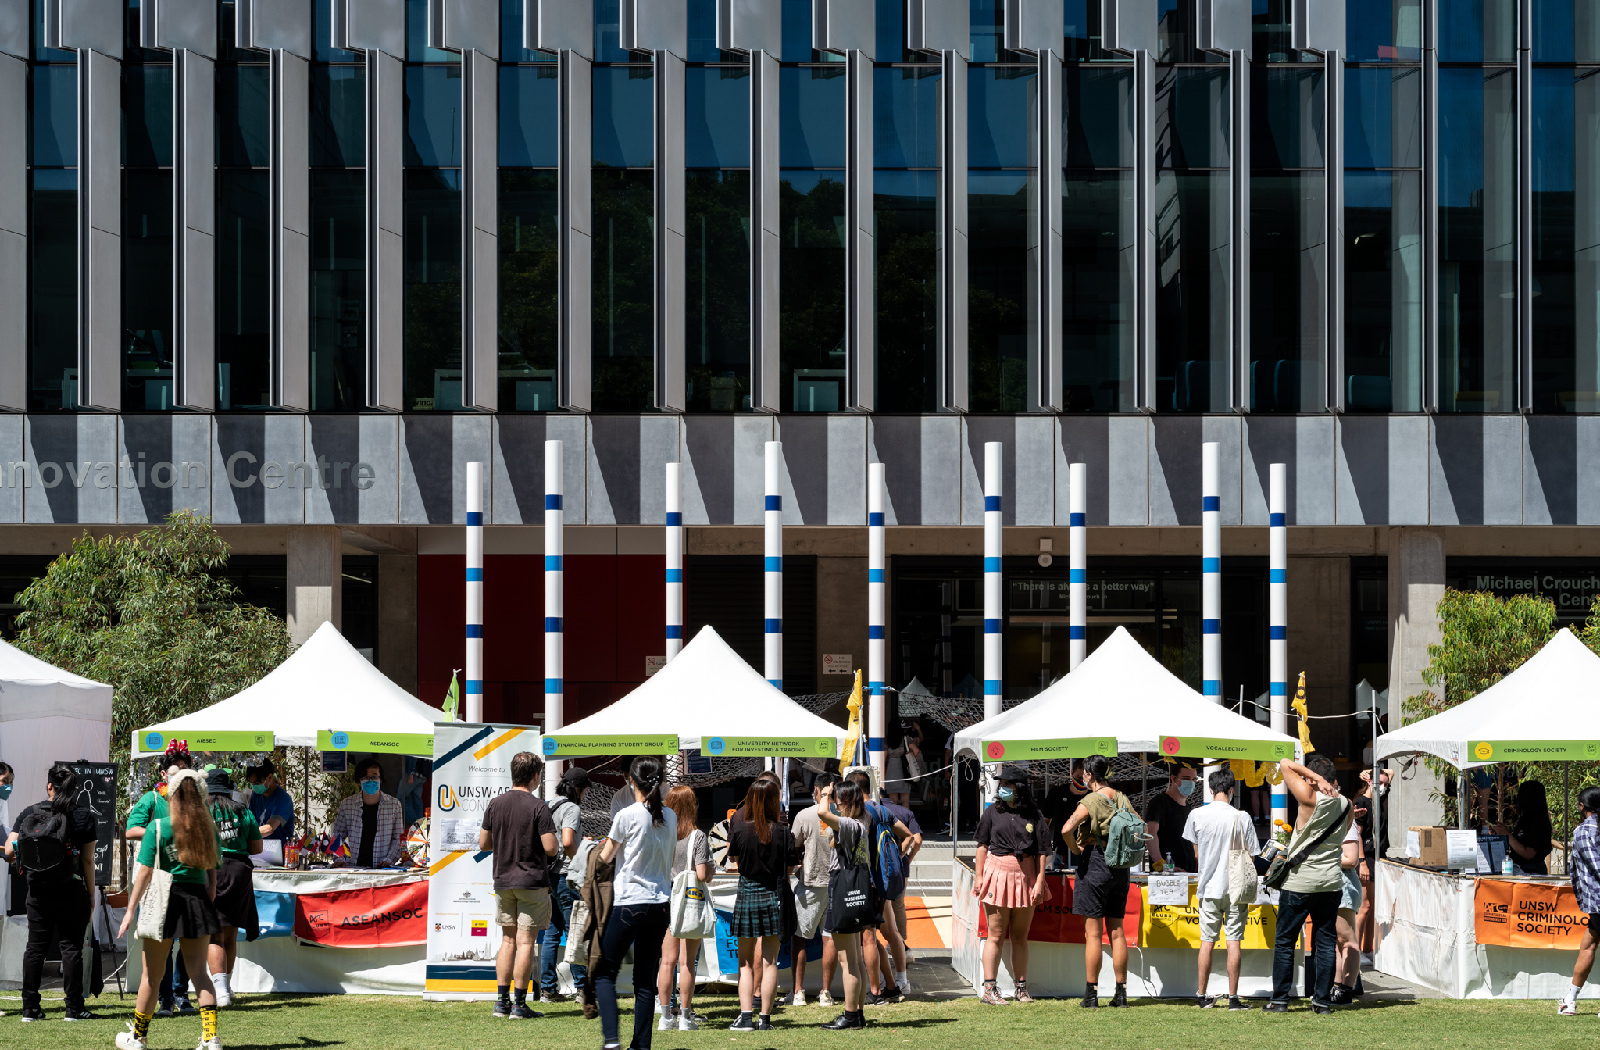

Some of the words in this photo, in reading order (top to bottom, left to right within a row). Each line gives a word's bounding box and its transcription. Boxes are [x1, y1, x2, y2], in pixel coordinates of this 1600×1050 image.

[0, 451, 207, 490] novation
[226, 450, 376, 490] Centre
[1047, 581, 1056, 591] is
[1058, 582, 1090, 591] alws
[1093, 583, 1099, 591] a
[1101, 582, 1129, 591] better
[1476, 575, 1539, 590] Michael
[1542, 575, 1600, 590] Crouch
[1559, 592, 1595, 606] Cent
[468, 765, 498, 773] Welcome
[688, 889, 703, 898] IKA
[844, 894, 867, 902] BUSINESS
[846, 900, 866, 908] SOCIETY
[1519, 900, 1558, 913] UNSW
[341, 907, 424, 927] ASEANSOC
[1517, 911, 1589, 927] CRIMINOLO
[1516, 922, 1572, 936] SOCIETY
